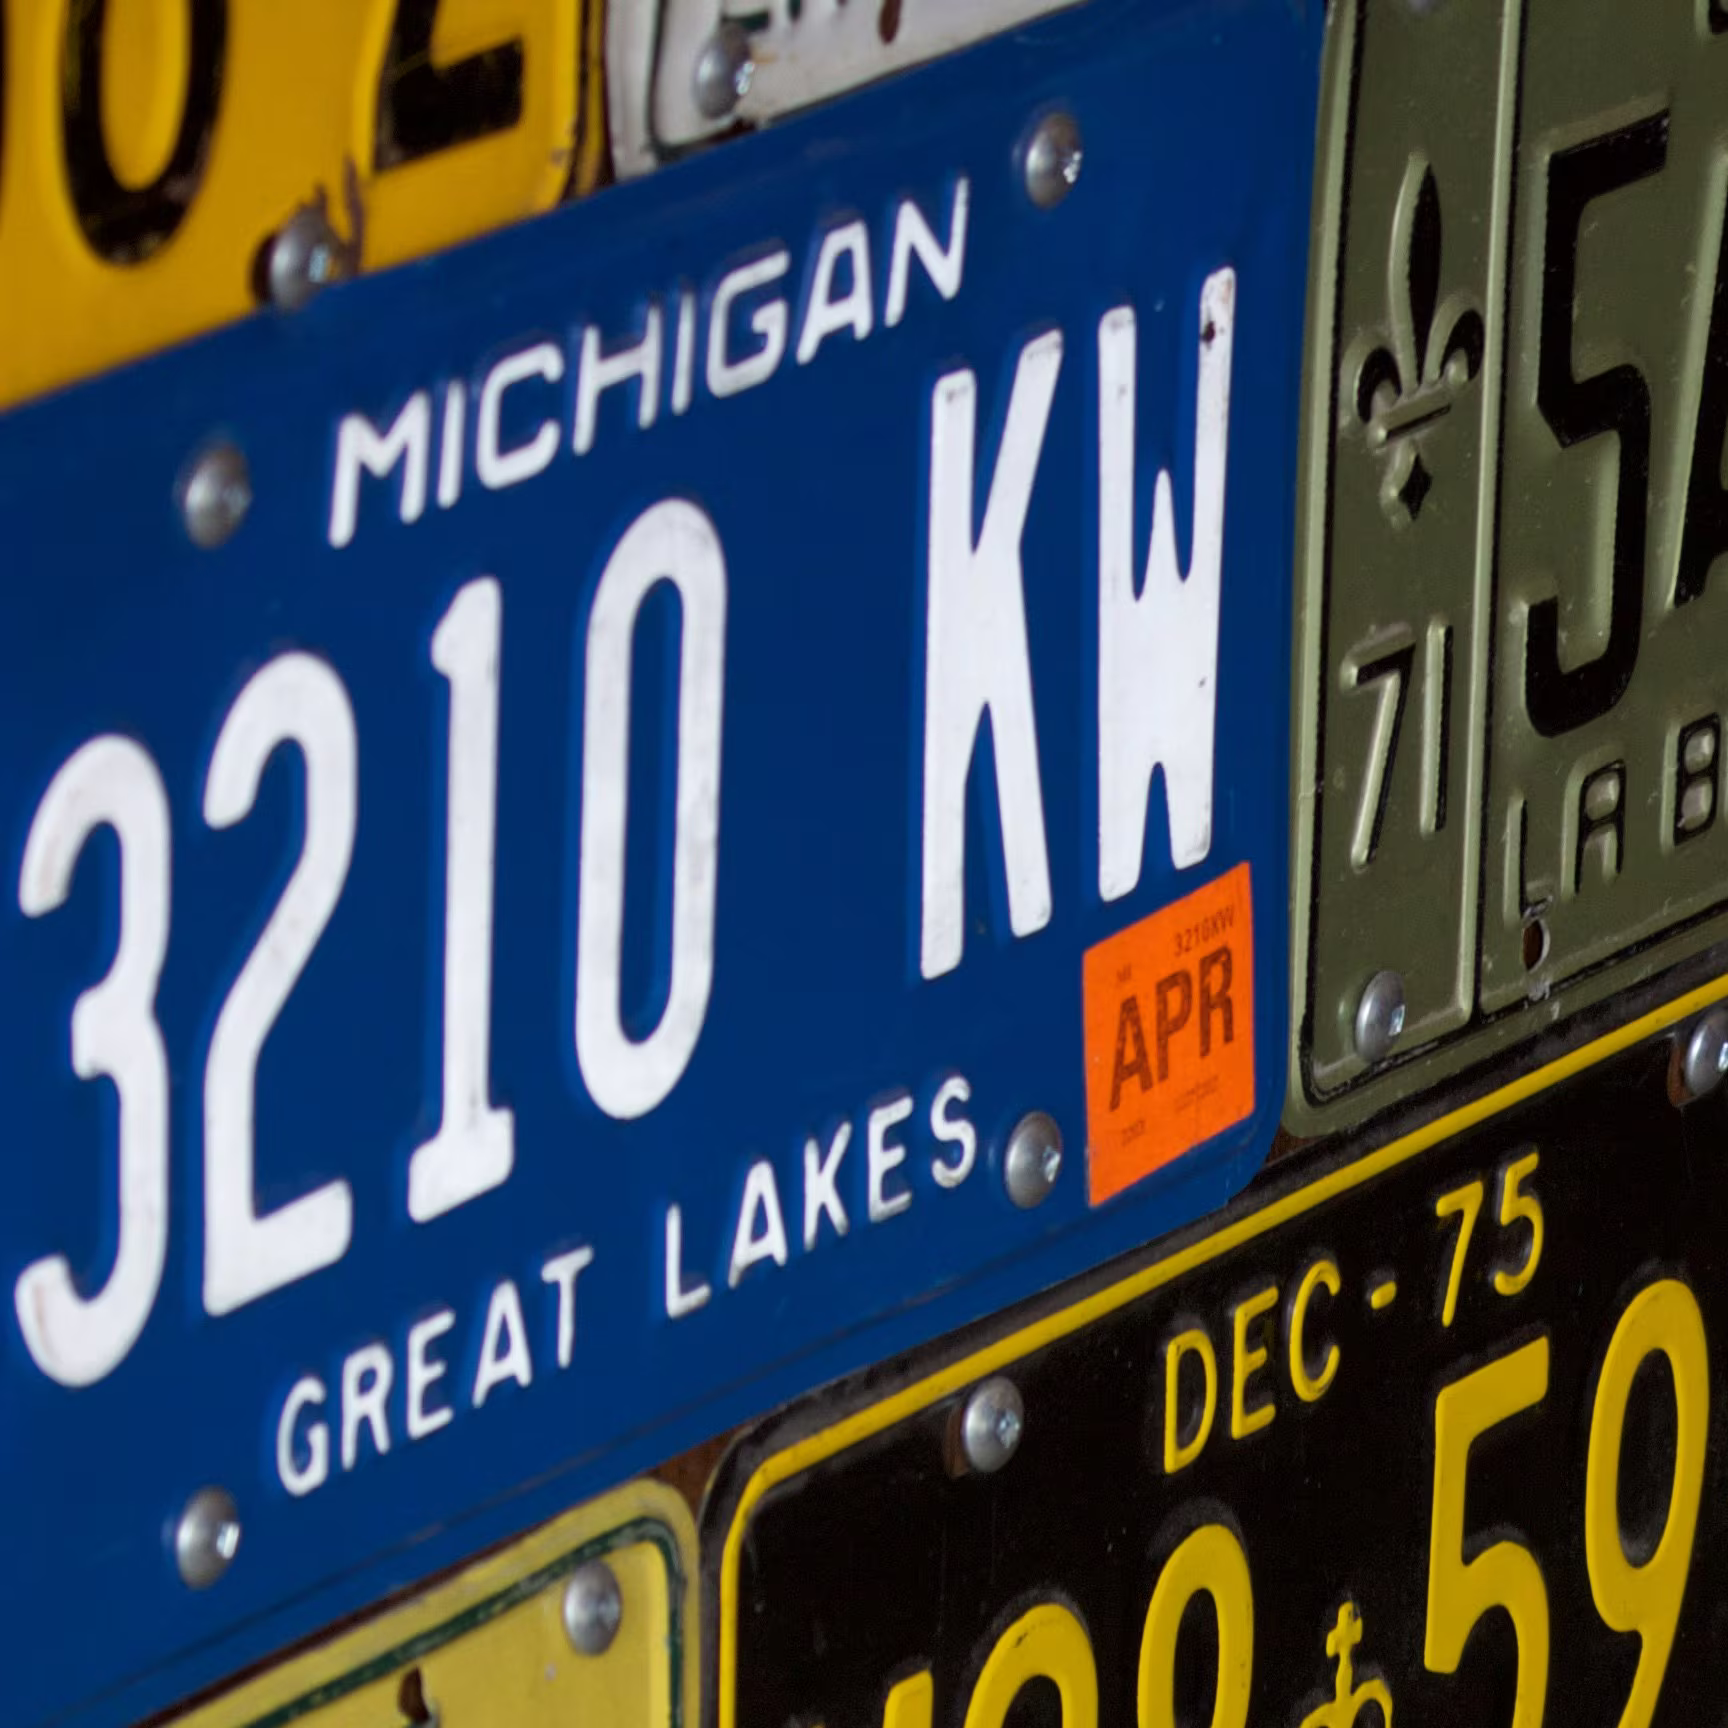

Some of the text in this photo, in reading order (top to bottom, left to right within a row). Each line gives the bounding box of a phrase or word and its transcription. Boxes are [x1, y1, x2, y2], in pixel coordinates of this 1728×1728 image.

[330, 176, 970, 548] MICHIGAN
[15, 267, 1236, 1388] 3210 KW
[1353, 626, 1452, 867] 71
[1508, 759, 1626, 920] LA
[1108, 944, 1235, 1112] APR
[276, 1076, 978, 1497] GREAT LAKES
